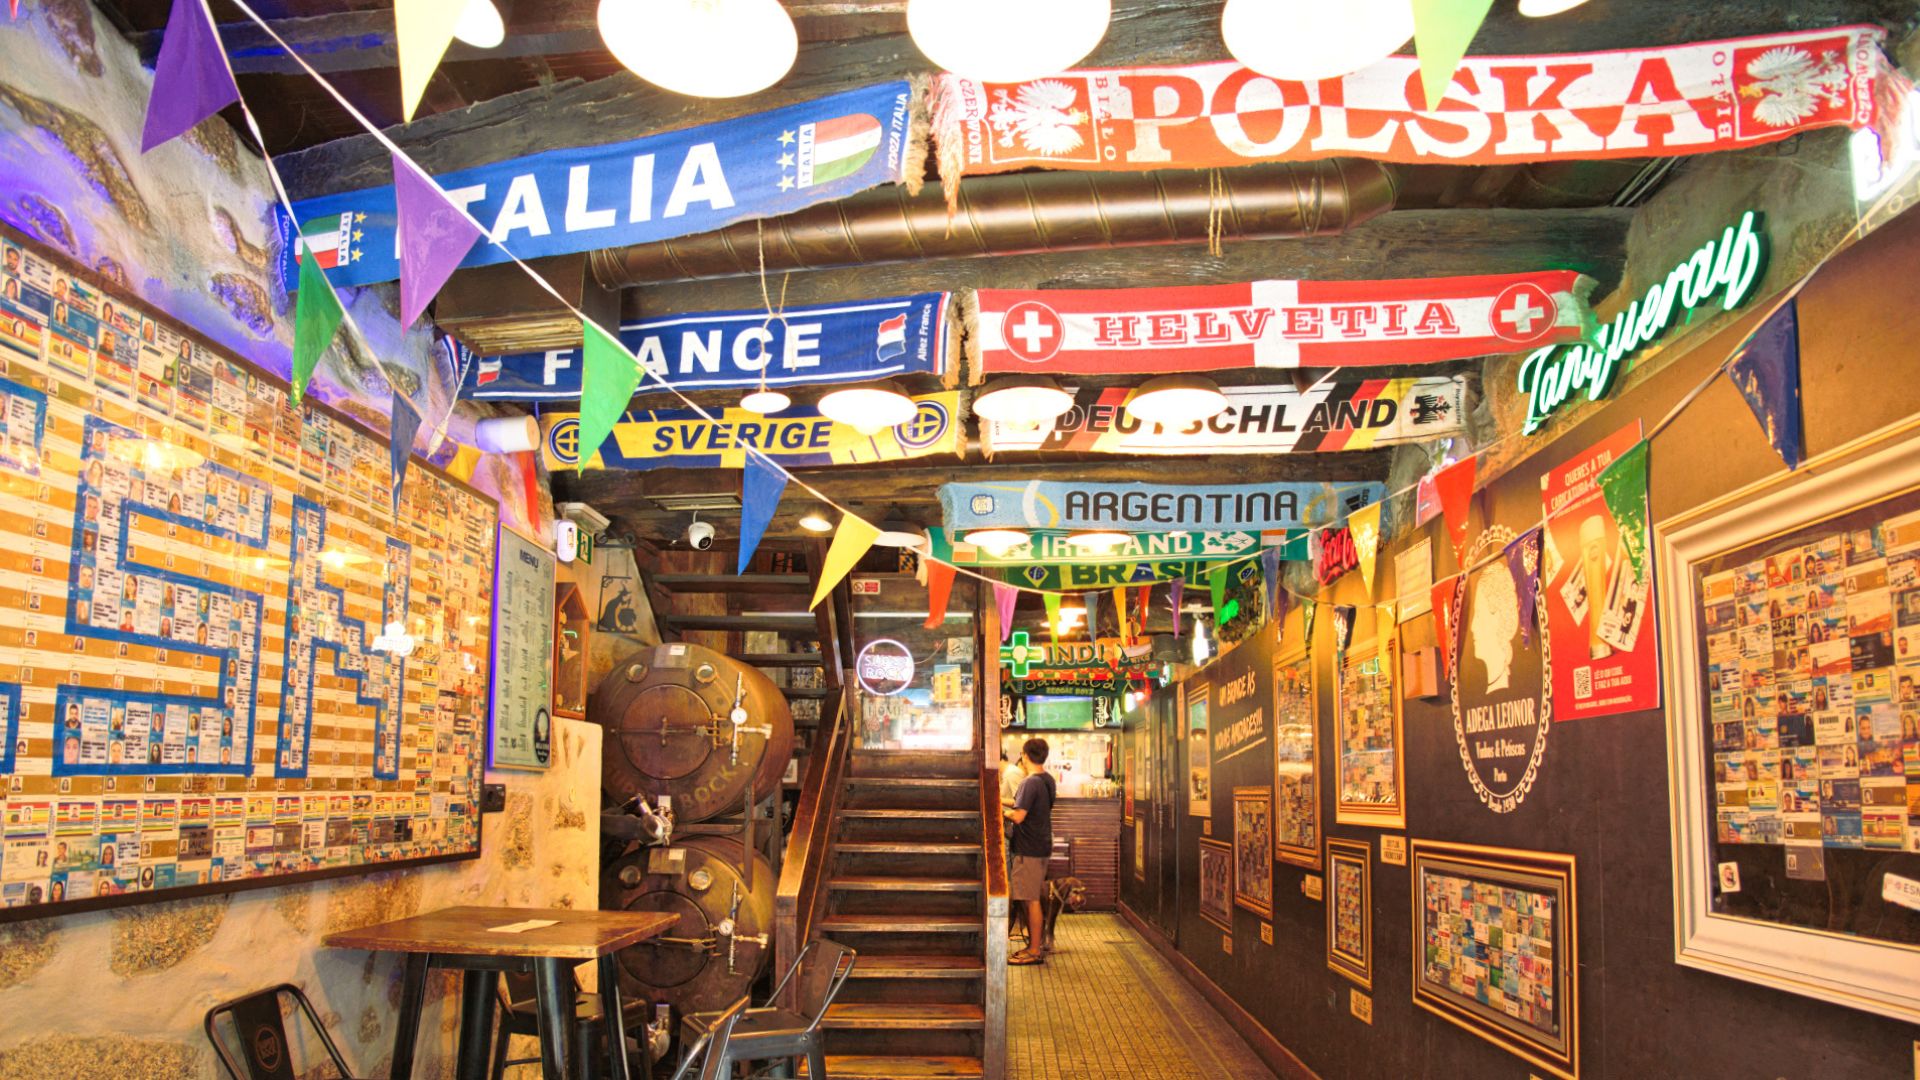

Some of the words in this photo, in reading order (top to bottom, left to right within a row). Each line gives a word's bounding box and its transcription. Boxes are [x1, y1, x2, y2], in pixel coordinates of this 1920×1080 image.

[892, 93, 908, 132] ITALIA
[1123, 56, 1716, 160] POLSKA
[802, 128, 813, 184] ITALIA
[339, 213, 351, 263] ITALIA
[919, 303, 933, 337] France
[1093, 302, 1461, 347] HELVETIA
[1517, 210, 1760, 437] Tanqueray
[543, 322, 823, 387] FANCE
[652, 420, 834, 453] SVERIGE
[1564, 461, 1590, 486] QUERES
[1597, 449, 1613, 469] TUA
[1065, 490, 1298, 524] ARGENTINA
[519, 548, 539, 569] MENU
[1071, 560, 1211, 586] BRASIL
[1466, 704, 1496, 733] ADEGA
[1496, 697, 1536, 730] LEONOR
[1475, 741, 1494, 759] Vinhos
[1501, 738, 1526, 758] Petiscos
